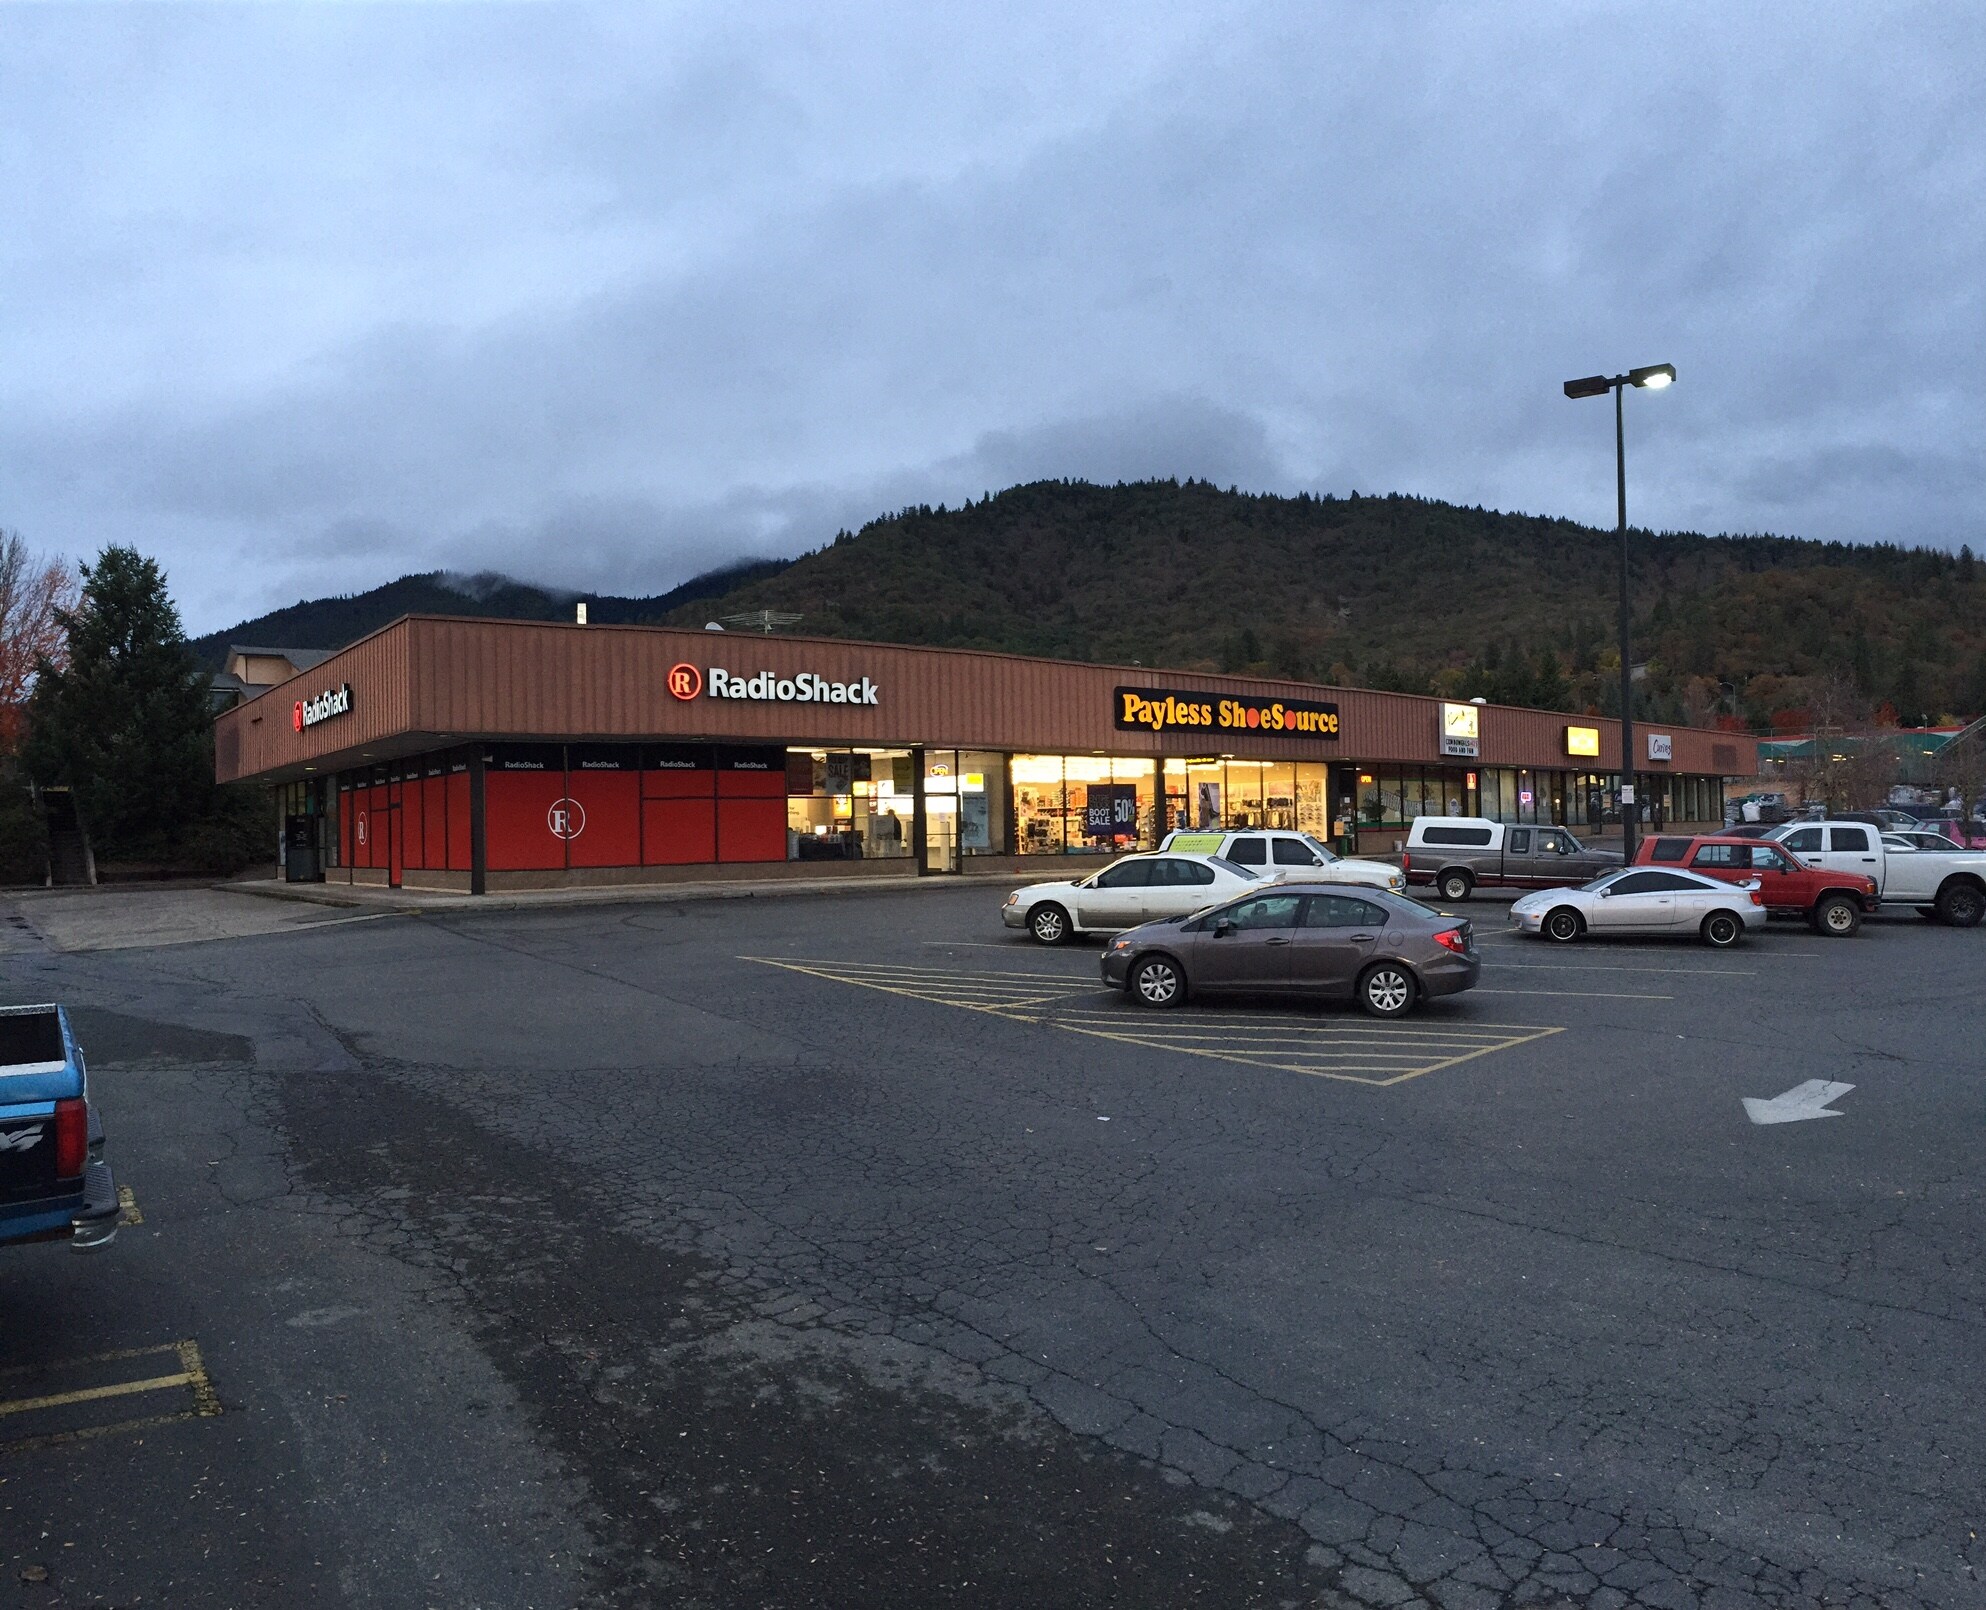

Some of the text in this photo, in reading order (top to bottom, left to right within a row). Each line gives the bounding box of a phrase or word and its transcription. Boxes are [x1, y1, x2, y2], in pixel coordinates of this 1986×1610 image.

[708, 667, 880, 705] RadioShack
[302, 683, 349, 727] RadioShack
[1122, 693, 1339, 733] Payless ShoeSource
[505, 761, 544, 769] RadioShack
[1089, 808, 1111, 817] BOOT
[1089, 816, 1111, 826] SALE
[1114, 799, 1135, 823] 50%
